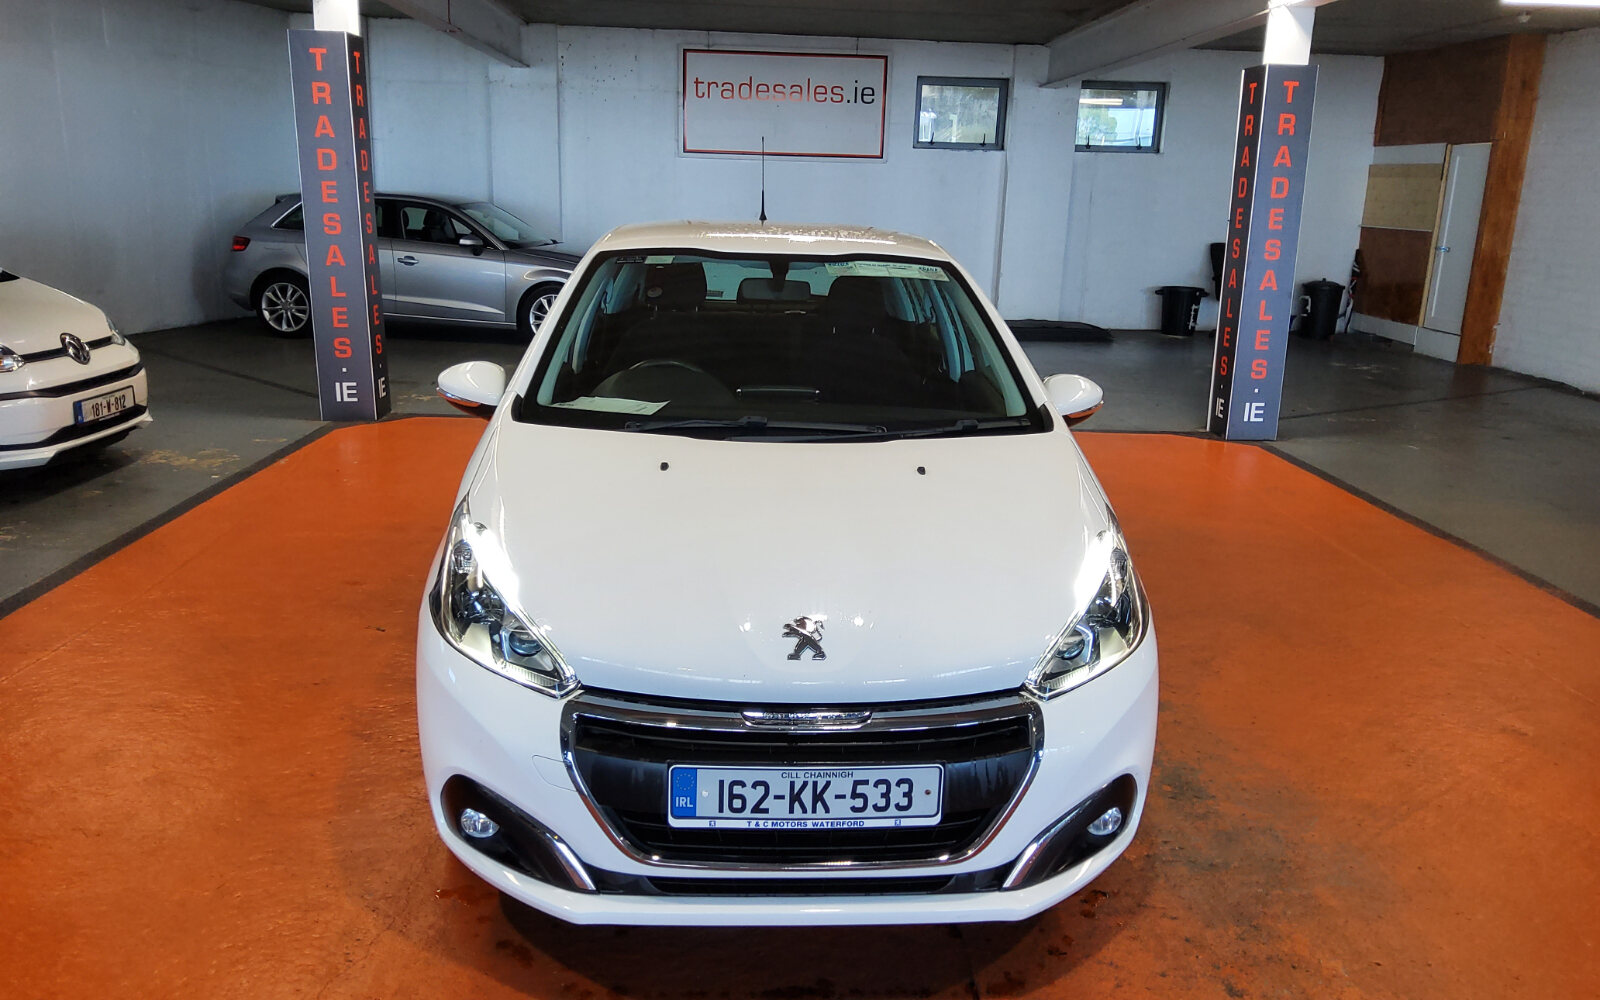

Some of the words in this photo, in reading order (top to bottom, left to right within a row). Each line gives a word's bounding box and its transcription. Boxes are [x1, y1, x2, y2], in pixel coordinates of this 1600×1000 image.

[694, 76, 875, 104] tradesales.ie
[781, 771, 801, 779] CILL
[803, 771, 854, 779] CHAINNIGH
[675, 796, 694, 808] IRL
[717, 777, 914, 815] 162-KK-533
[811, 820, 865, 828] WATERFORD
